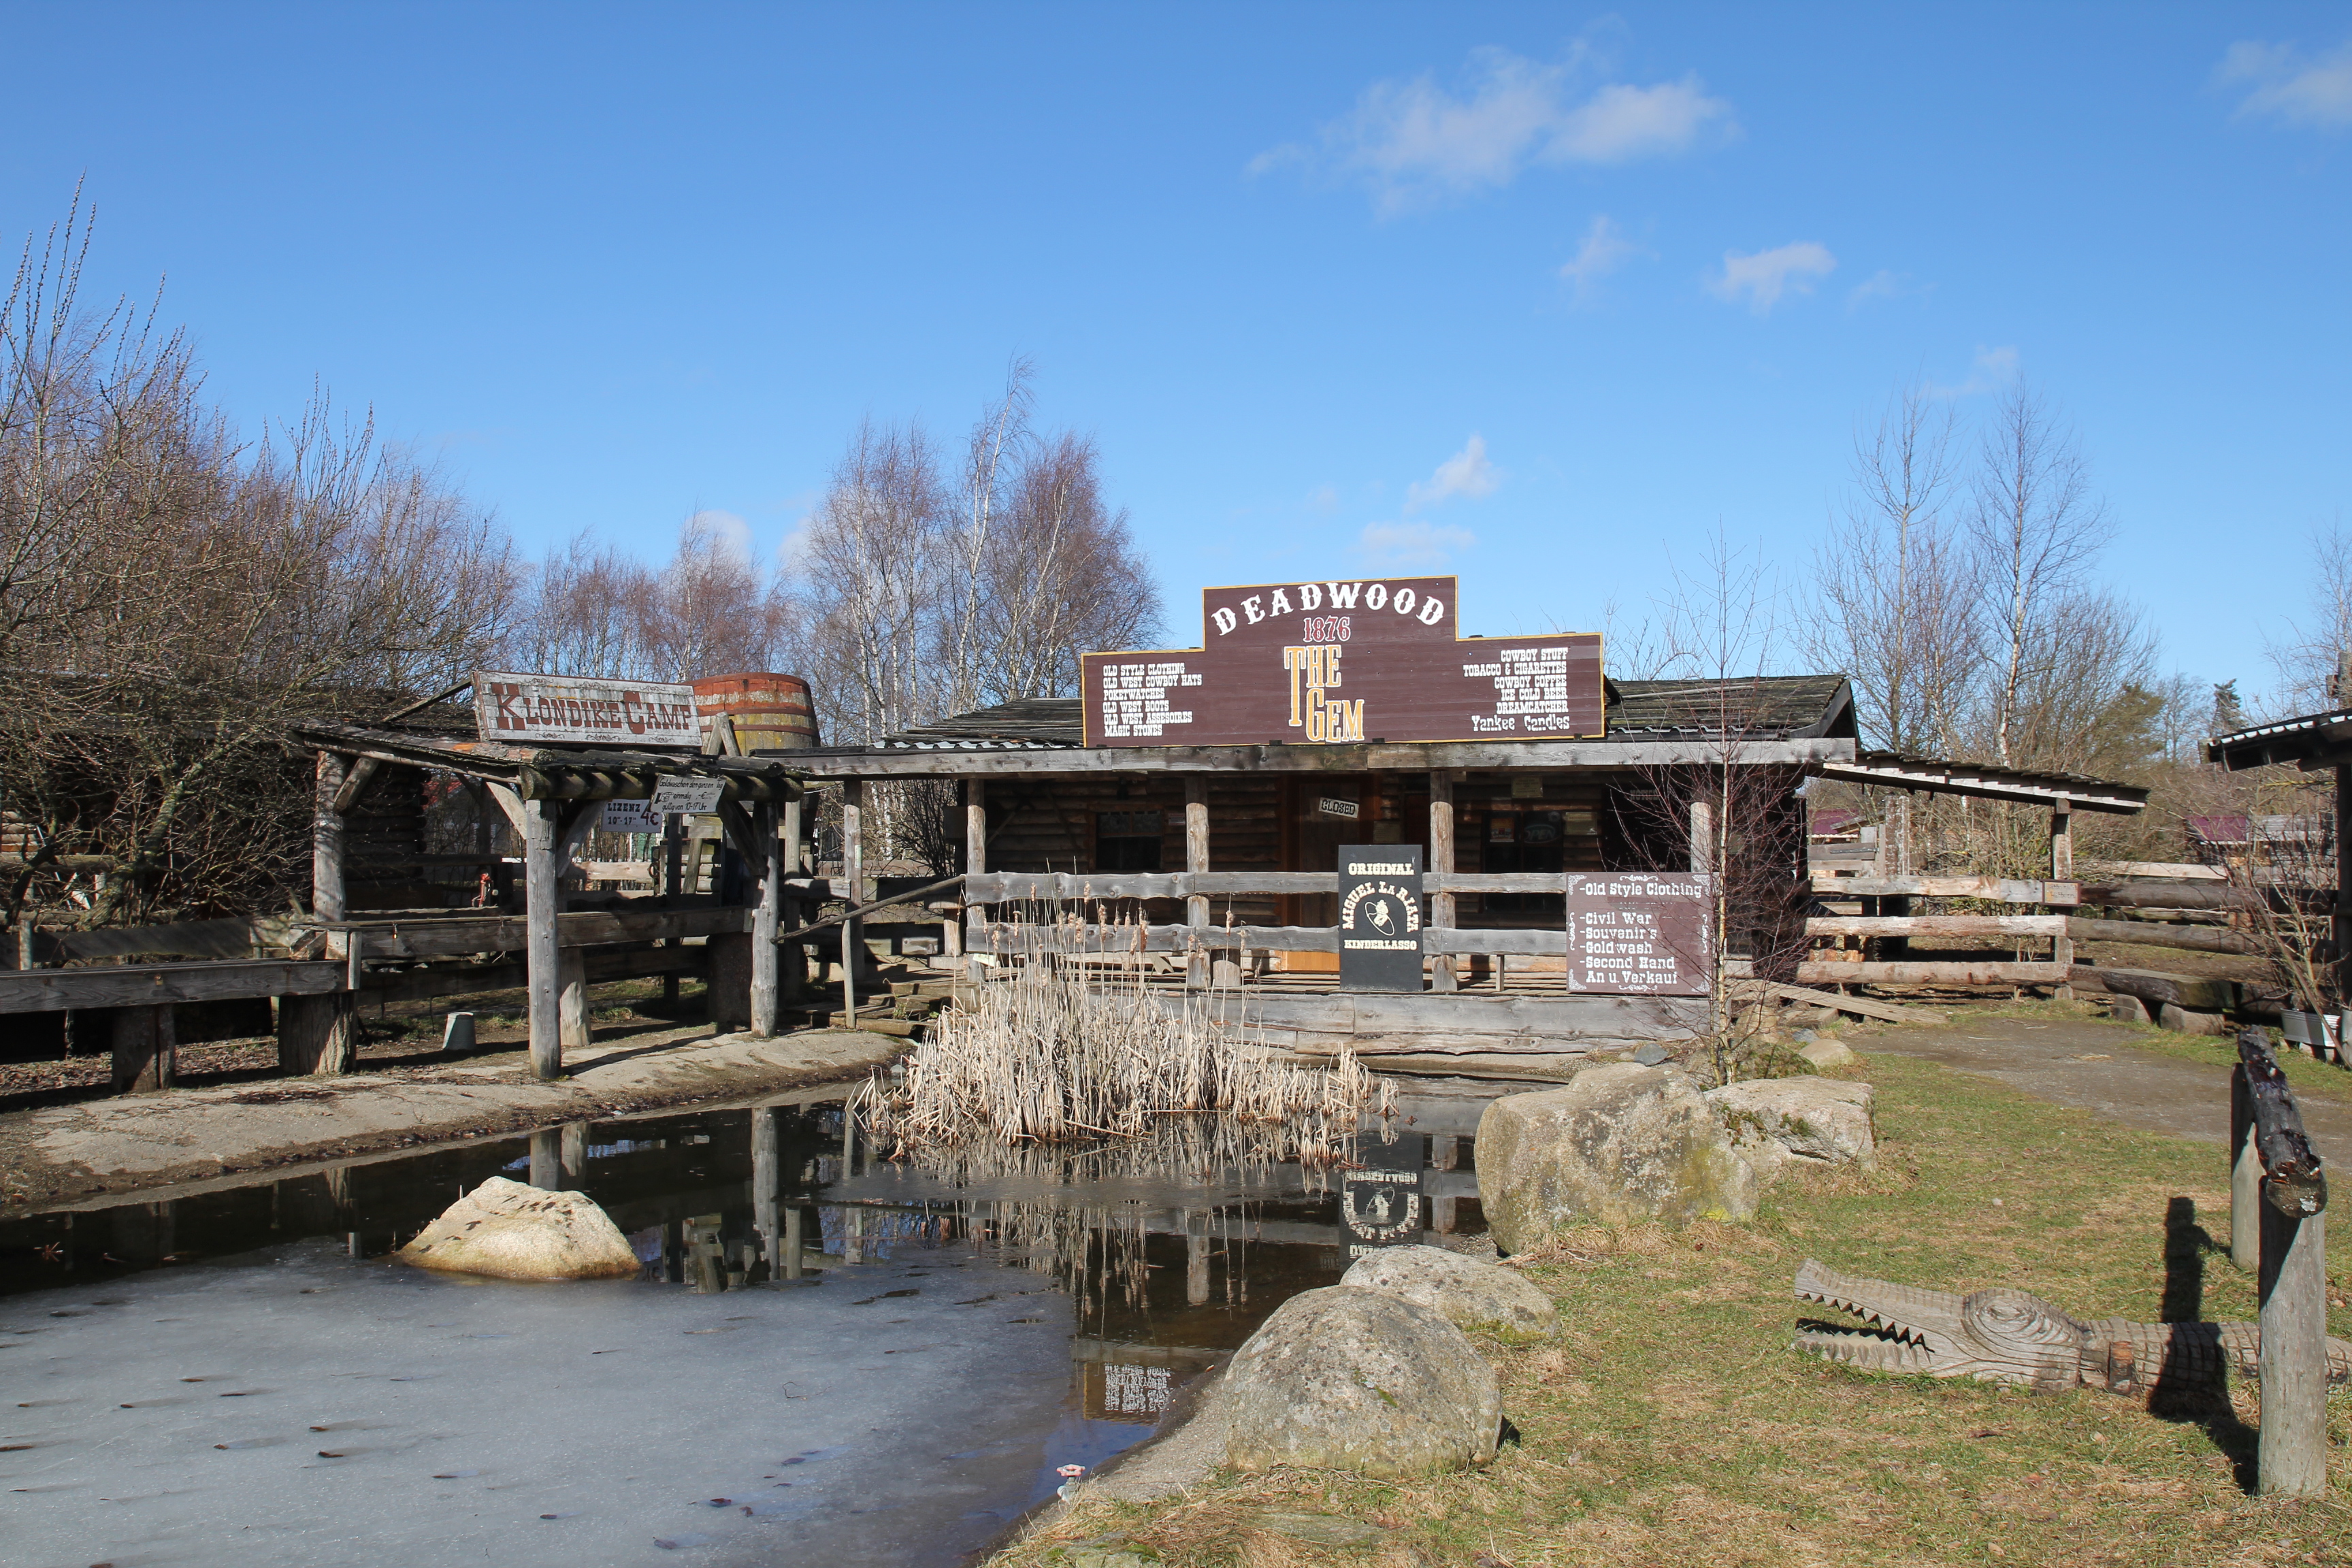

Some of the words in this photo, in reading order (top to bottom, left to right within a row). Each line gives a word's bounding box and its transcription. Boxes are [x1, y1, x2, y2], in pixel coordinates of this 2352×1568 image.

[1211, 582, 1444, 636] DEADWOOD
[1303, 615, 1351, 642] 1876
[1501, 649, 1537, 662] COWBOY
[1541, 647, 1568, 661] STUFF
[1103, 665, 1117, 676] OLD
[1121, 664, 1145, 676] STYLE
[1147, 662, 1185, 675] CLOTHING
[1463, 664, 1501, 677] TOBACCO
[1505, 663, 1511, 676] &
[1514, 661, 1567, 675] CIGARETTES
[1103, 677, 1117, 689] OLD
[1120, 676, 1143, 688] WEST
[1145, 675, 1178, 687] COWBOY
[1181, 674, 1202, 686] HATS
[1284, 644, 1342, 727] THE
[1494, 676, 1531, 689] COWBOY
[1534, 674, 1567, 687] COFFEE
[1103, 687, 1165, 701] POKETWATCHES
[1501, 689, 1515, 701] ICE
[1519, 688, 1540, 700] COLD
[1544, 687, 1568, 700] BEER
[491, 682, 622, 730] KLONDIKE
[623, 690, 691, 734] CAMP
[1103, 702, 1117, 713] OLD
[1120, 701, 1142, 713] WEST
[1145, 700, 1169, 712] BOOTS
[1497, 700, 1569, 715] DREAMCATCHER
[1104, 714, 1118, 725] OLD
[1121, 713, 1143, 724] WEST
[1146, 711, 1192, 724] ASSESOIRES
[1305, 687, 1365, 743] GEM
[1105, 725, 1130, 737] MAGIC
[1133, 724, 1162, 736] STONES
[1471, 715, 1515, 732] Yankee
[1524, 714, 1570, 732] Candles
[607, 802, 640, 812] LIZENZ
[1321, 799, 1356, 815] CLOSED
[1348, 862, 1414, 876] ORIGINAL
[1610, 883, 1642, 898] Style
[1646, 883, 1701, 898] Clothing
[1342, 881, 1375, 930] MIGUEL
[1622, 912, 1652, 924] War
[1344, 939, 1417, 950] KINDERLASSO
[1639, 957, 1675, 969] Hand
[1586, 970, 1605, 983] An
[1609, 974, 1620, 983] u.
[1622, 970, 1678, 984] Verkauf
